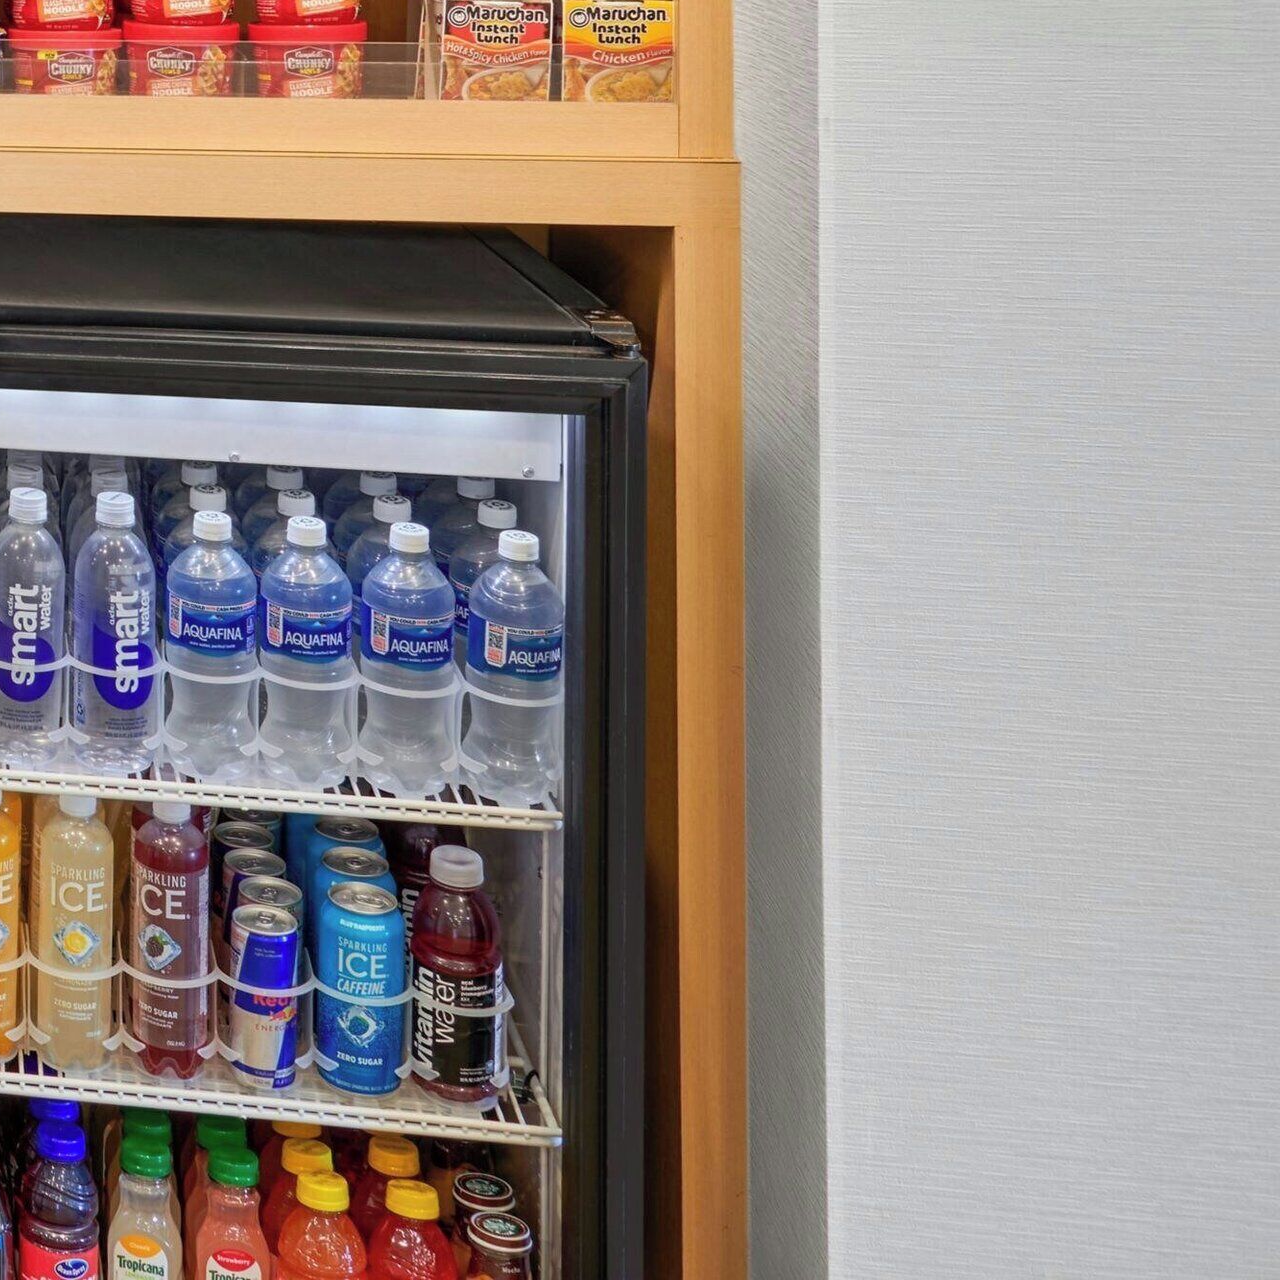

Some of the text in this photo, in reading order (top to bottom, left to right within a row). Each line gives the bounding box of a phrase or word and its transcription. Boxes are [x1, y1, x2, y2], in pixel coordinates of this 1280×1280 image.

[43, 3, 84, 15] NOODLE
[40, 585, 52, 629] water
[139, 589, 152, 637] water
[11, 584, 40, 686] smart
[115, 591, 140, 695] smart
[183, 623, 243, 646] AQUAFINA
[285, 631, 344, 651] AQUAFINA
[51, 863, 105, 881] SPARKLING
[337, 979, 385, 996] CAFFEINE
[117, 1255, 165, 1277] Tropicana
